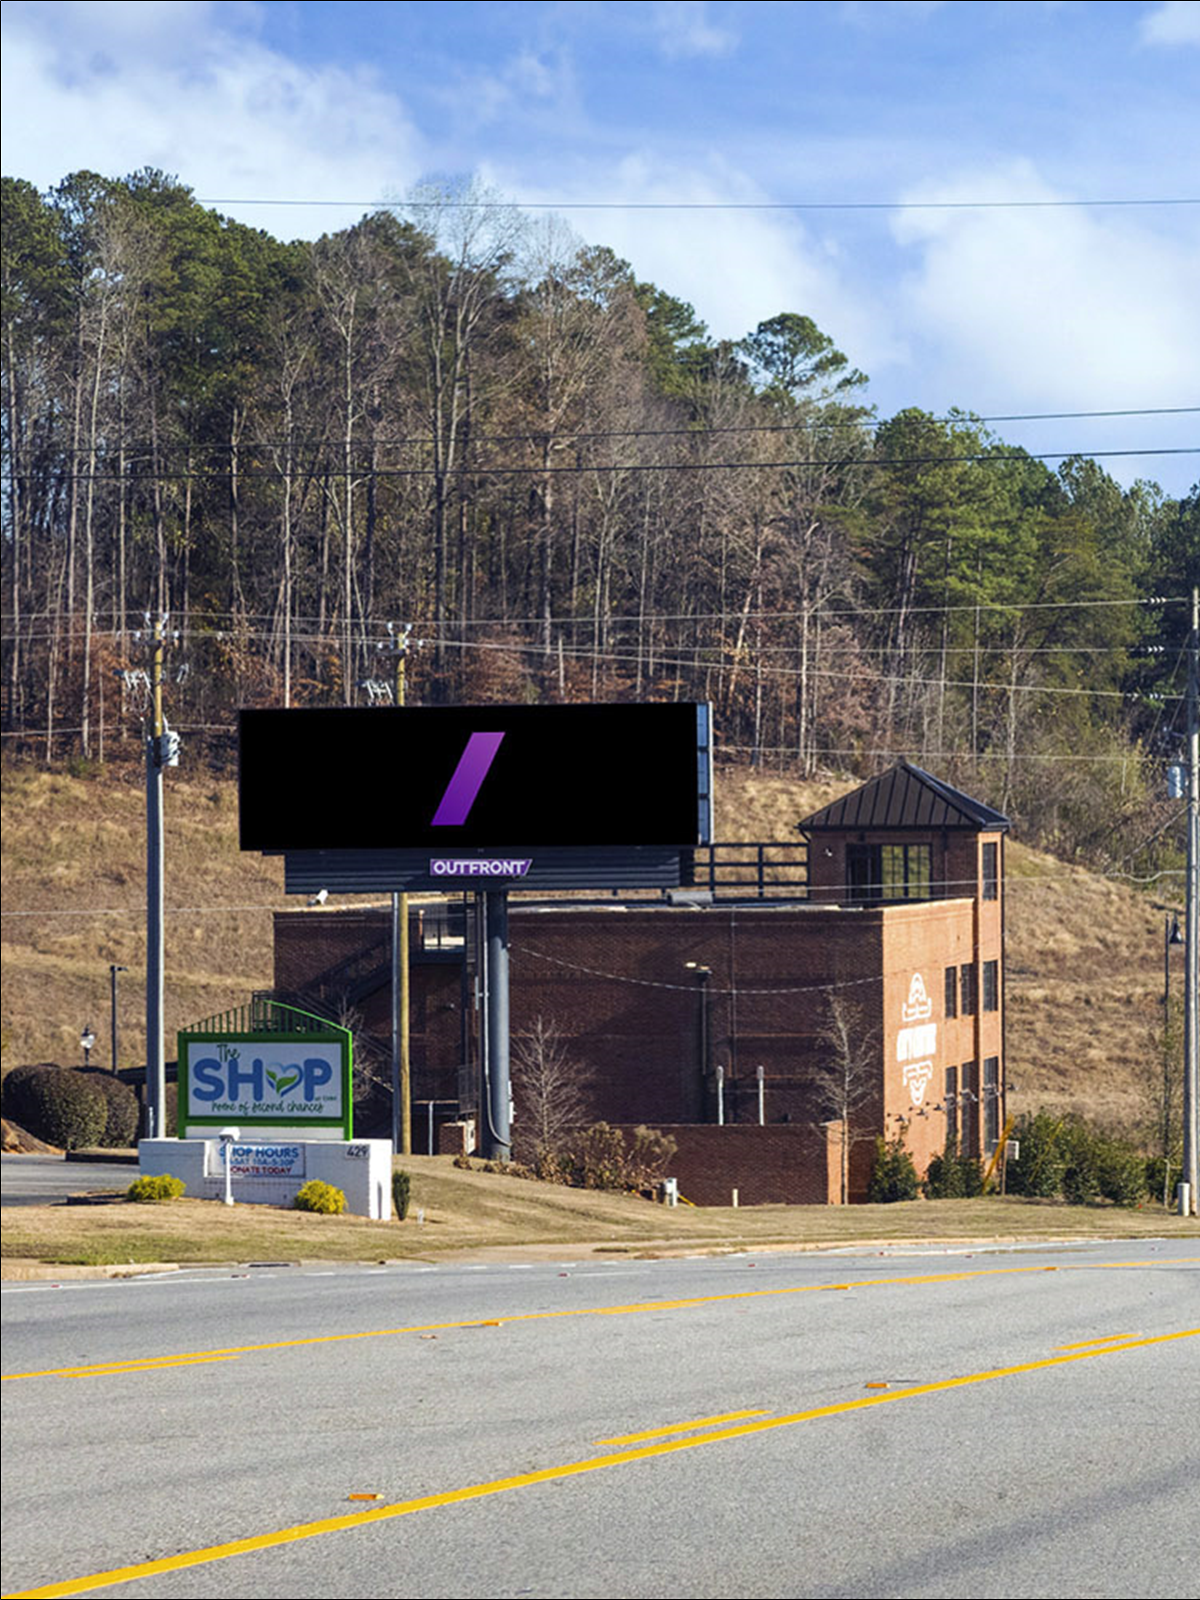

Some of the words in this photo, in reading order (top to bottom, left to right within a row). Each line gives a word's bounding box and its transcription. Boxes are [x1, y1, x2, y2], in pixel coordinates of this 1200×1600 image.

[433, 861, 525, 875] OUTFRONT
[217, 1044, 241, 1062] The
[211, 1101, 236, 1112] home
[238, 1101, 250, 1116] of
[252, 1101, 284, 1113] second
[287, 1101, 324, 1113] chances
[255, 1147, 299, 1158] HOURS
[346, 1147, 369, 1157] 429
[262, 1166, 292, 1174] TODAY
